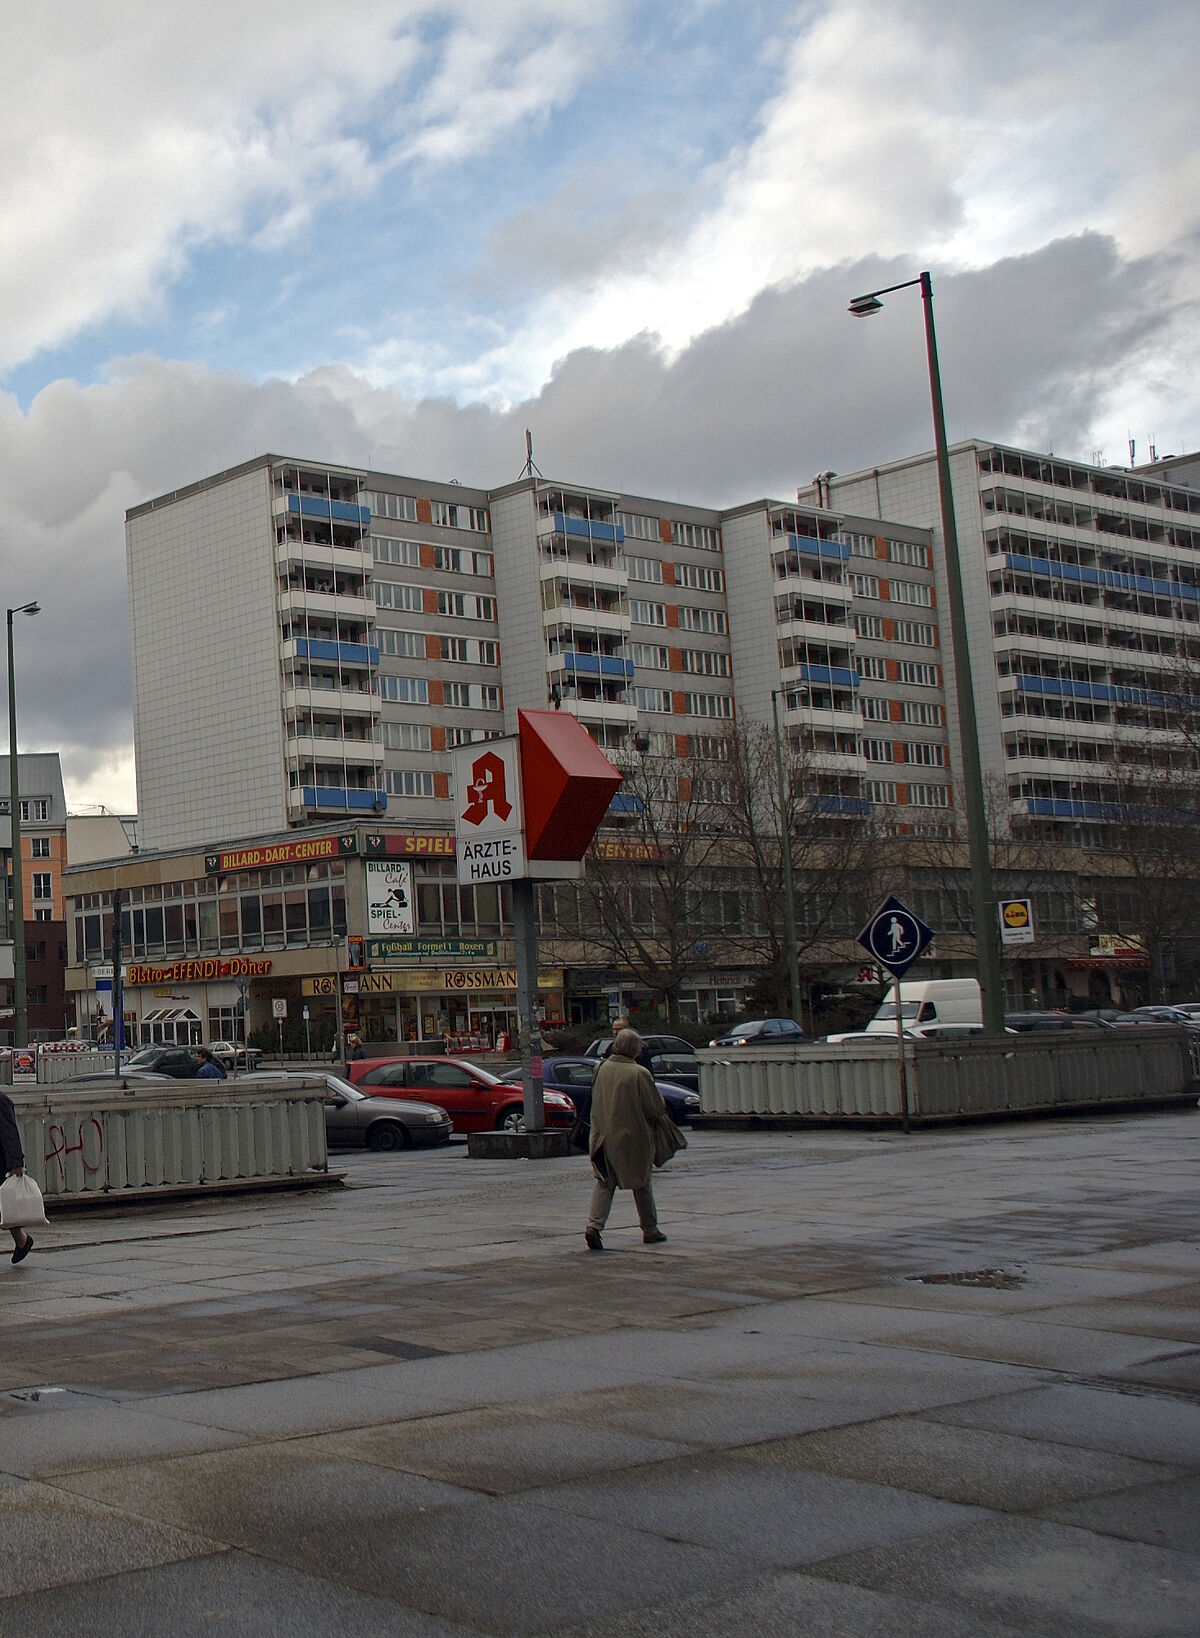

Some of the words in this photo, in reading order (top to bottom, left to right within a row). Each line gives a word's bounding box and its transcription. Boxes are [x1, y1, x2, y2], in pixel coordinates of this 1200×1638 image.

[405, 838, 453, 852] SPIEL
[463, 840, 517, 860] ÄRZTE-
[223, 840, 332, 868] BILLARD-DART-CENTER
[368, 863, 405, 873] BILLARD-
[471, 860, 512, 879] HAUS
[384, 873, 409, 886] Café
[371, 910, 401, 919] SPIEL-
[382, 919, 412, 930] Center
[381, 942, 412, 952] Fußball
[129, 965, 164, 983] Bistro
[173, 960, 221, 981] EFENDI
[230, 957, 272, 976] Döner
[313, 975, 392, 994] ROANN
[445, 971, 517, 988] ROSSMAN
